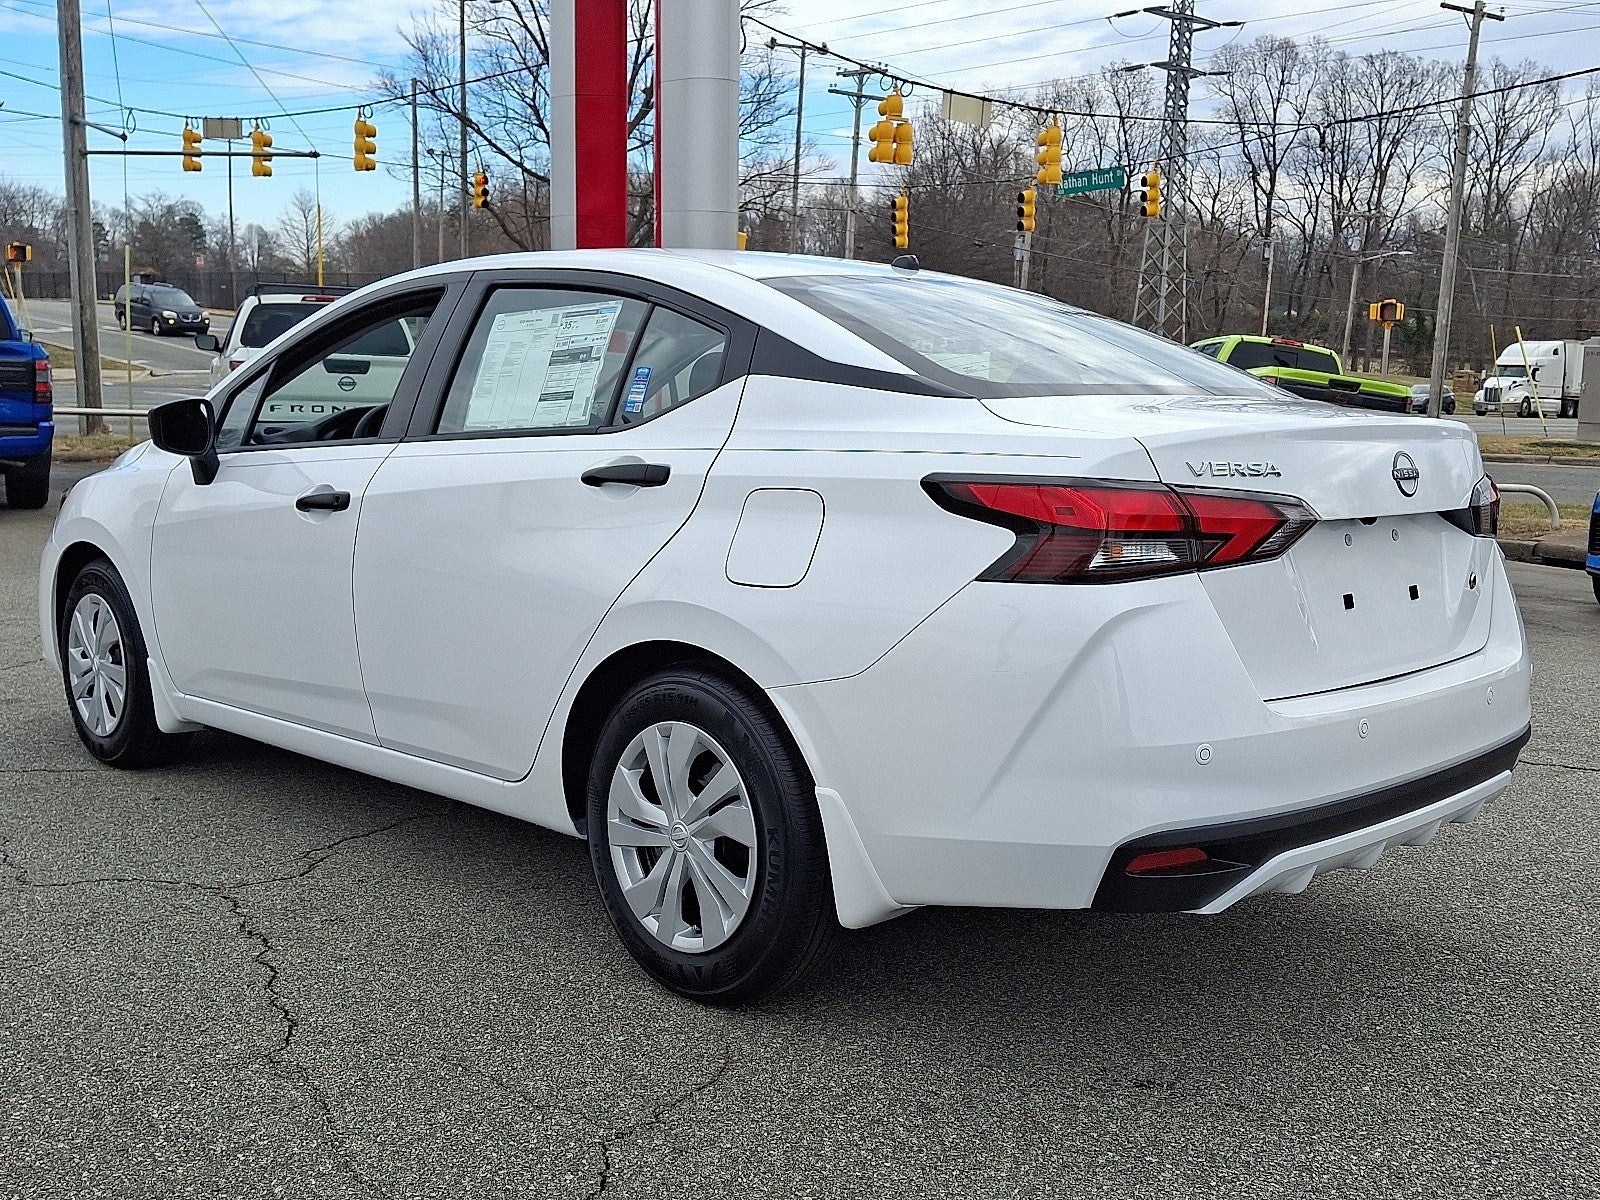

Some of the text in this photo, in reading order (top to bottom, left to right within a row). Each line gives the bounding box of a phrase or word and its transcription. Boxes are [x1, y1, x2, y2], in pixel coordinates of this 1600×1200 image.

[1058, 169, 1123, 189] Nathan Hunt Dr
[1185, 461, 1283, 478] VERSA
